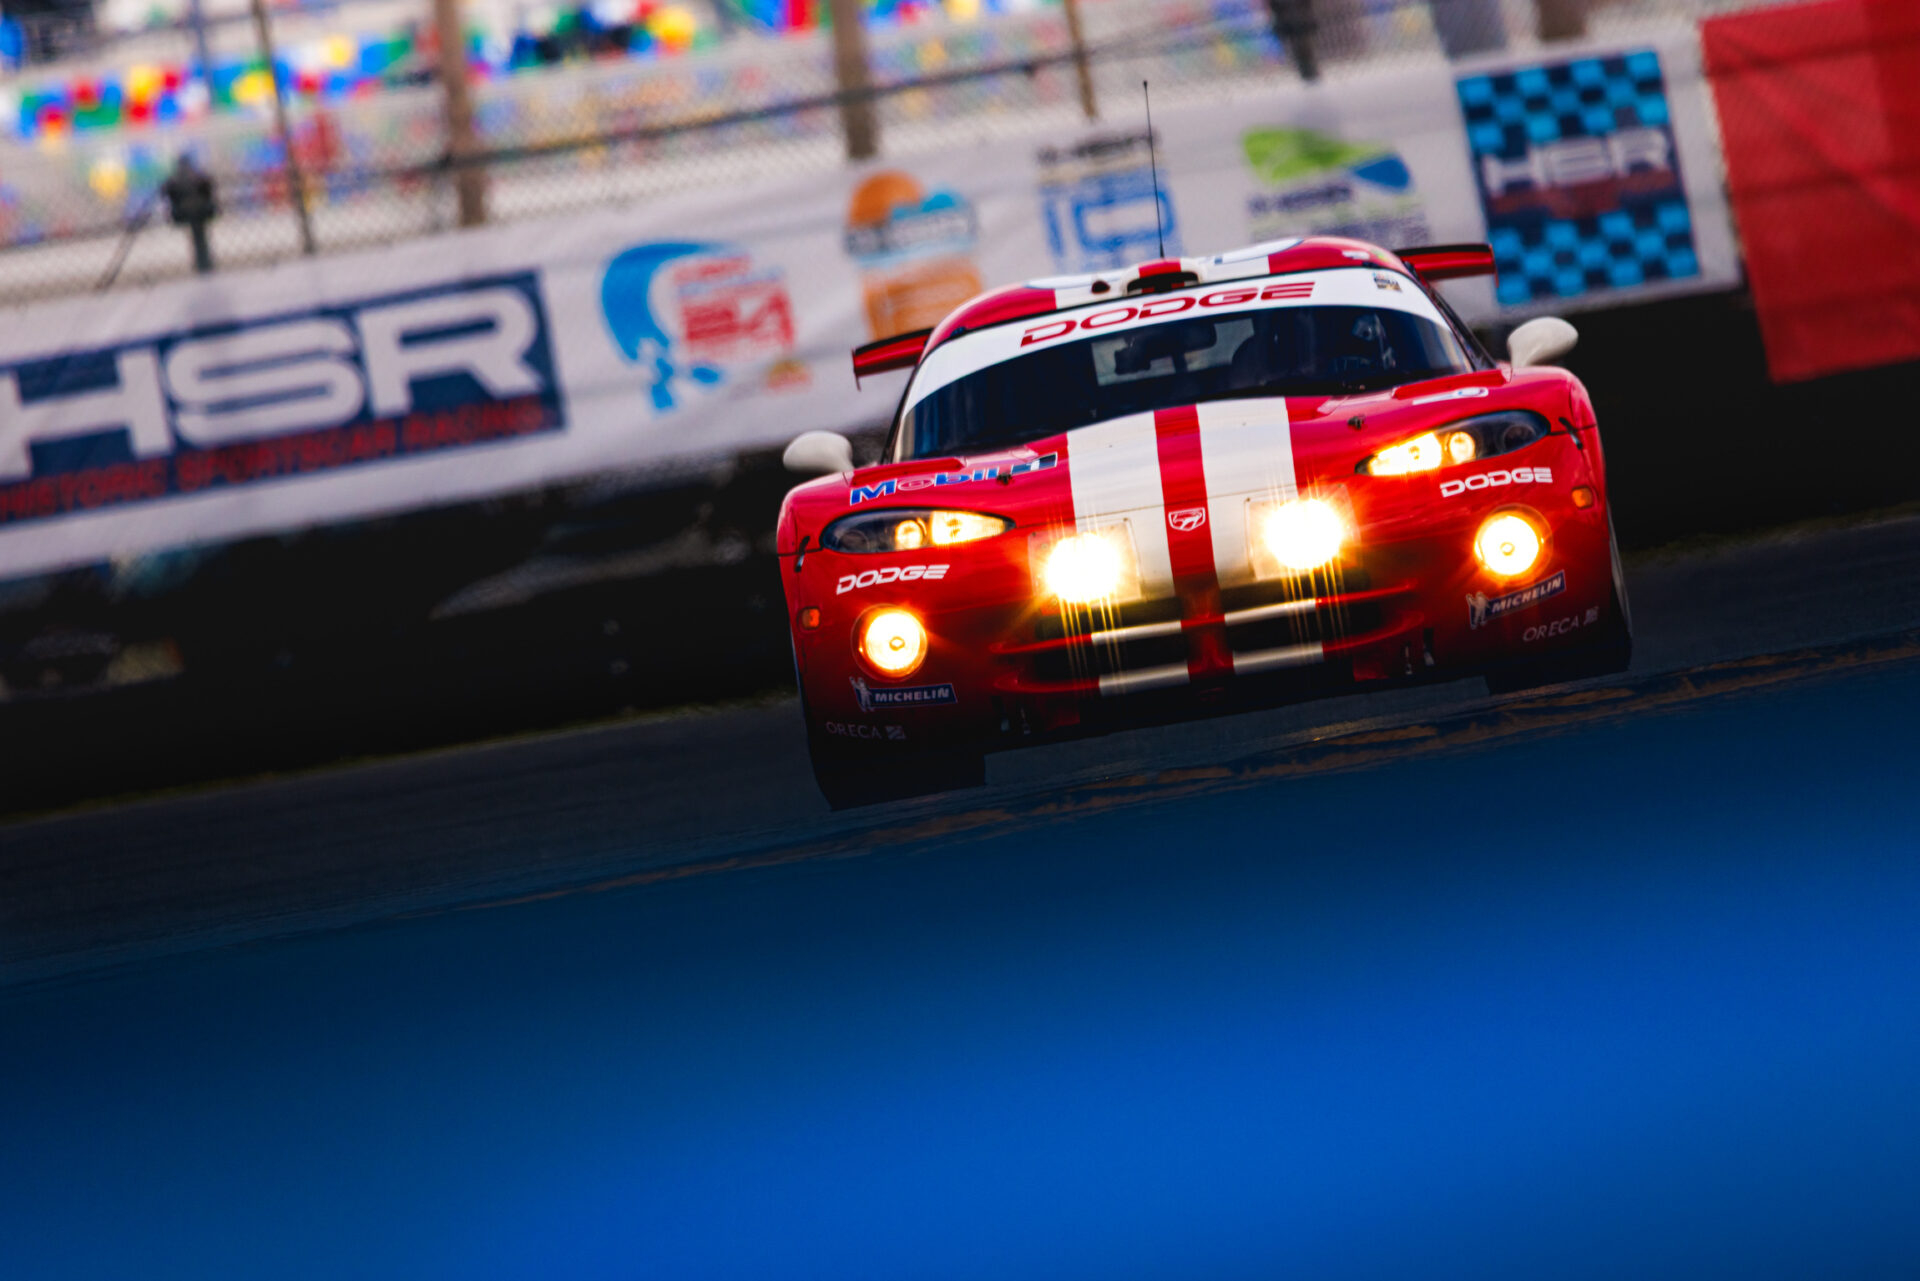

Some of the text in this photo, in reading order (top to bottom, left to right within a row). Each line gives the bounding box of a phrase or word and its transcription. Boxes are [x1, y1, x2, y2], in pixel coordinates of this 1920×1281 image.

[1020, 281, 1316, 348] DODGE
[0, 284, 547, 479] HSR
[850, 466, 1000, 506] Mobil
[1440, 466, 1553, 498] DODGE
[836, 563, 951, 596] DODGE
[1491, 577, 1562, 614] MICHELIN
[1522, 614, 1579, 643] ORECA
[874, 687, 950, 703] MICHELIN
[825, 720, 883, 740] ORECA
